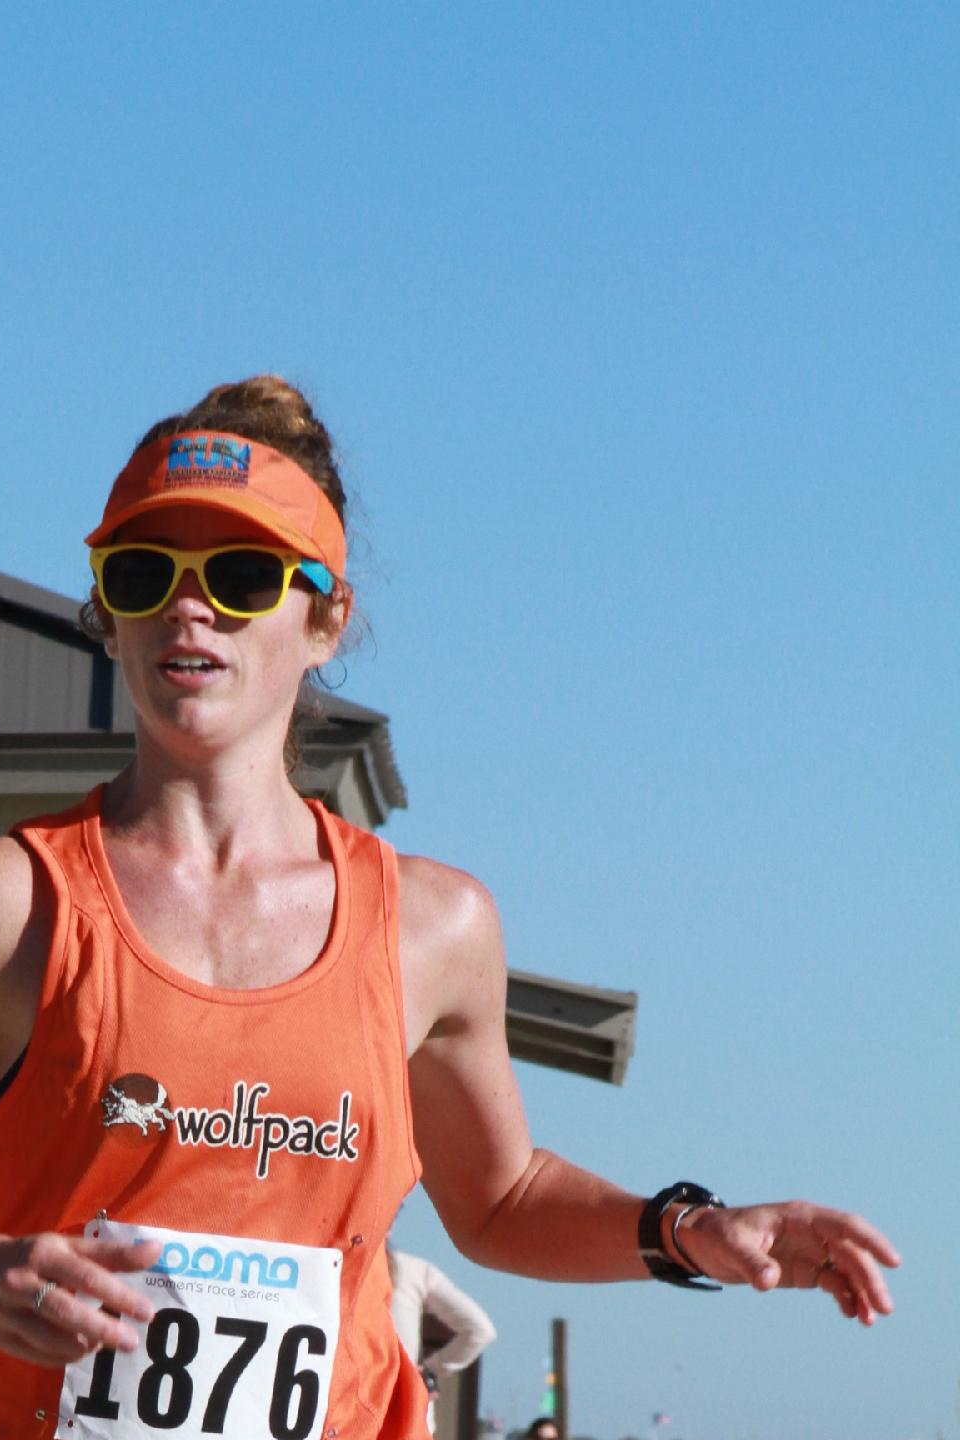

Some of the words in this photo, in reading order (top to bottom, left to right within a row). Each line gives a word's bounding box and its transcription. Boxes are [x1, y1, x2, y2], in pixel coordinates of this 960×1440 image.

[168, 436, 251, 470] RUN
[176, 1081, 359, 1179] wolfpack
[134, 1238, 299, 1289] ooma
[145, 1277, 203, 1293] women's
[207, 1284, 236, 1297] race
[240, 1288, 280, 1303] series
